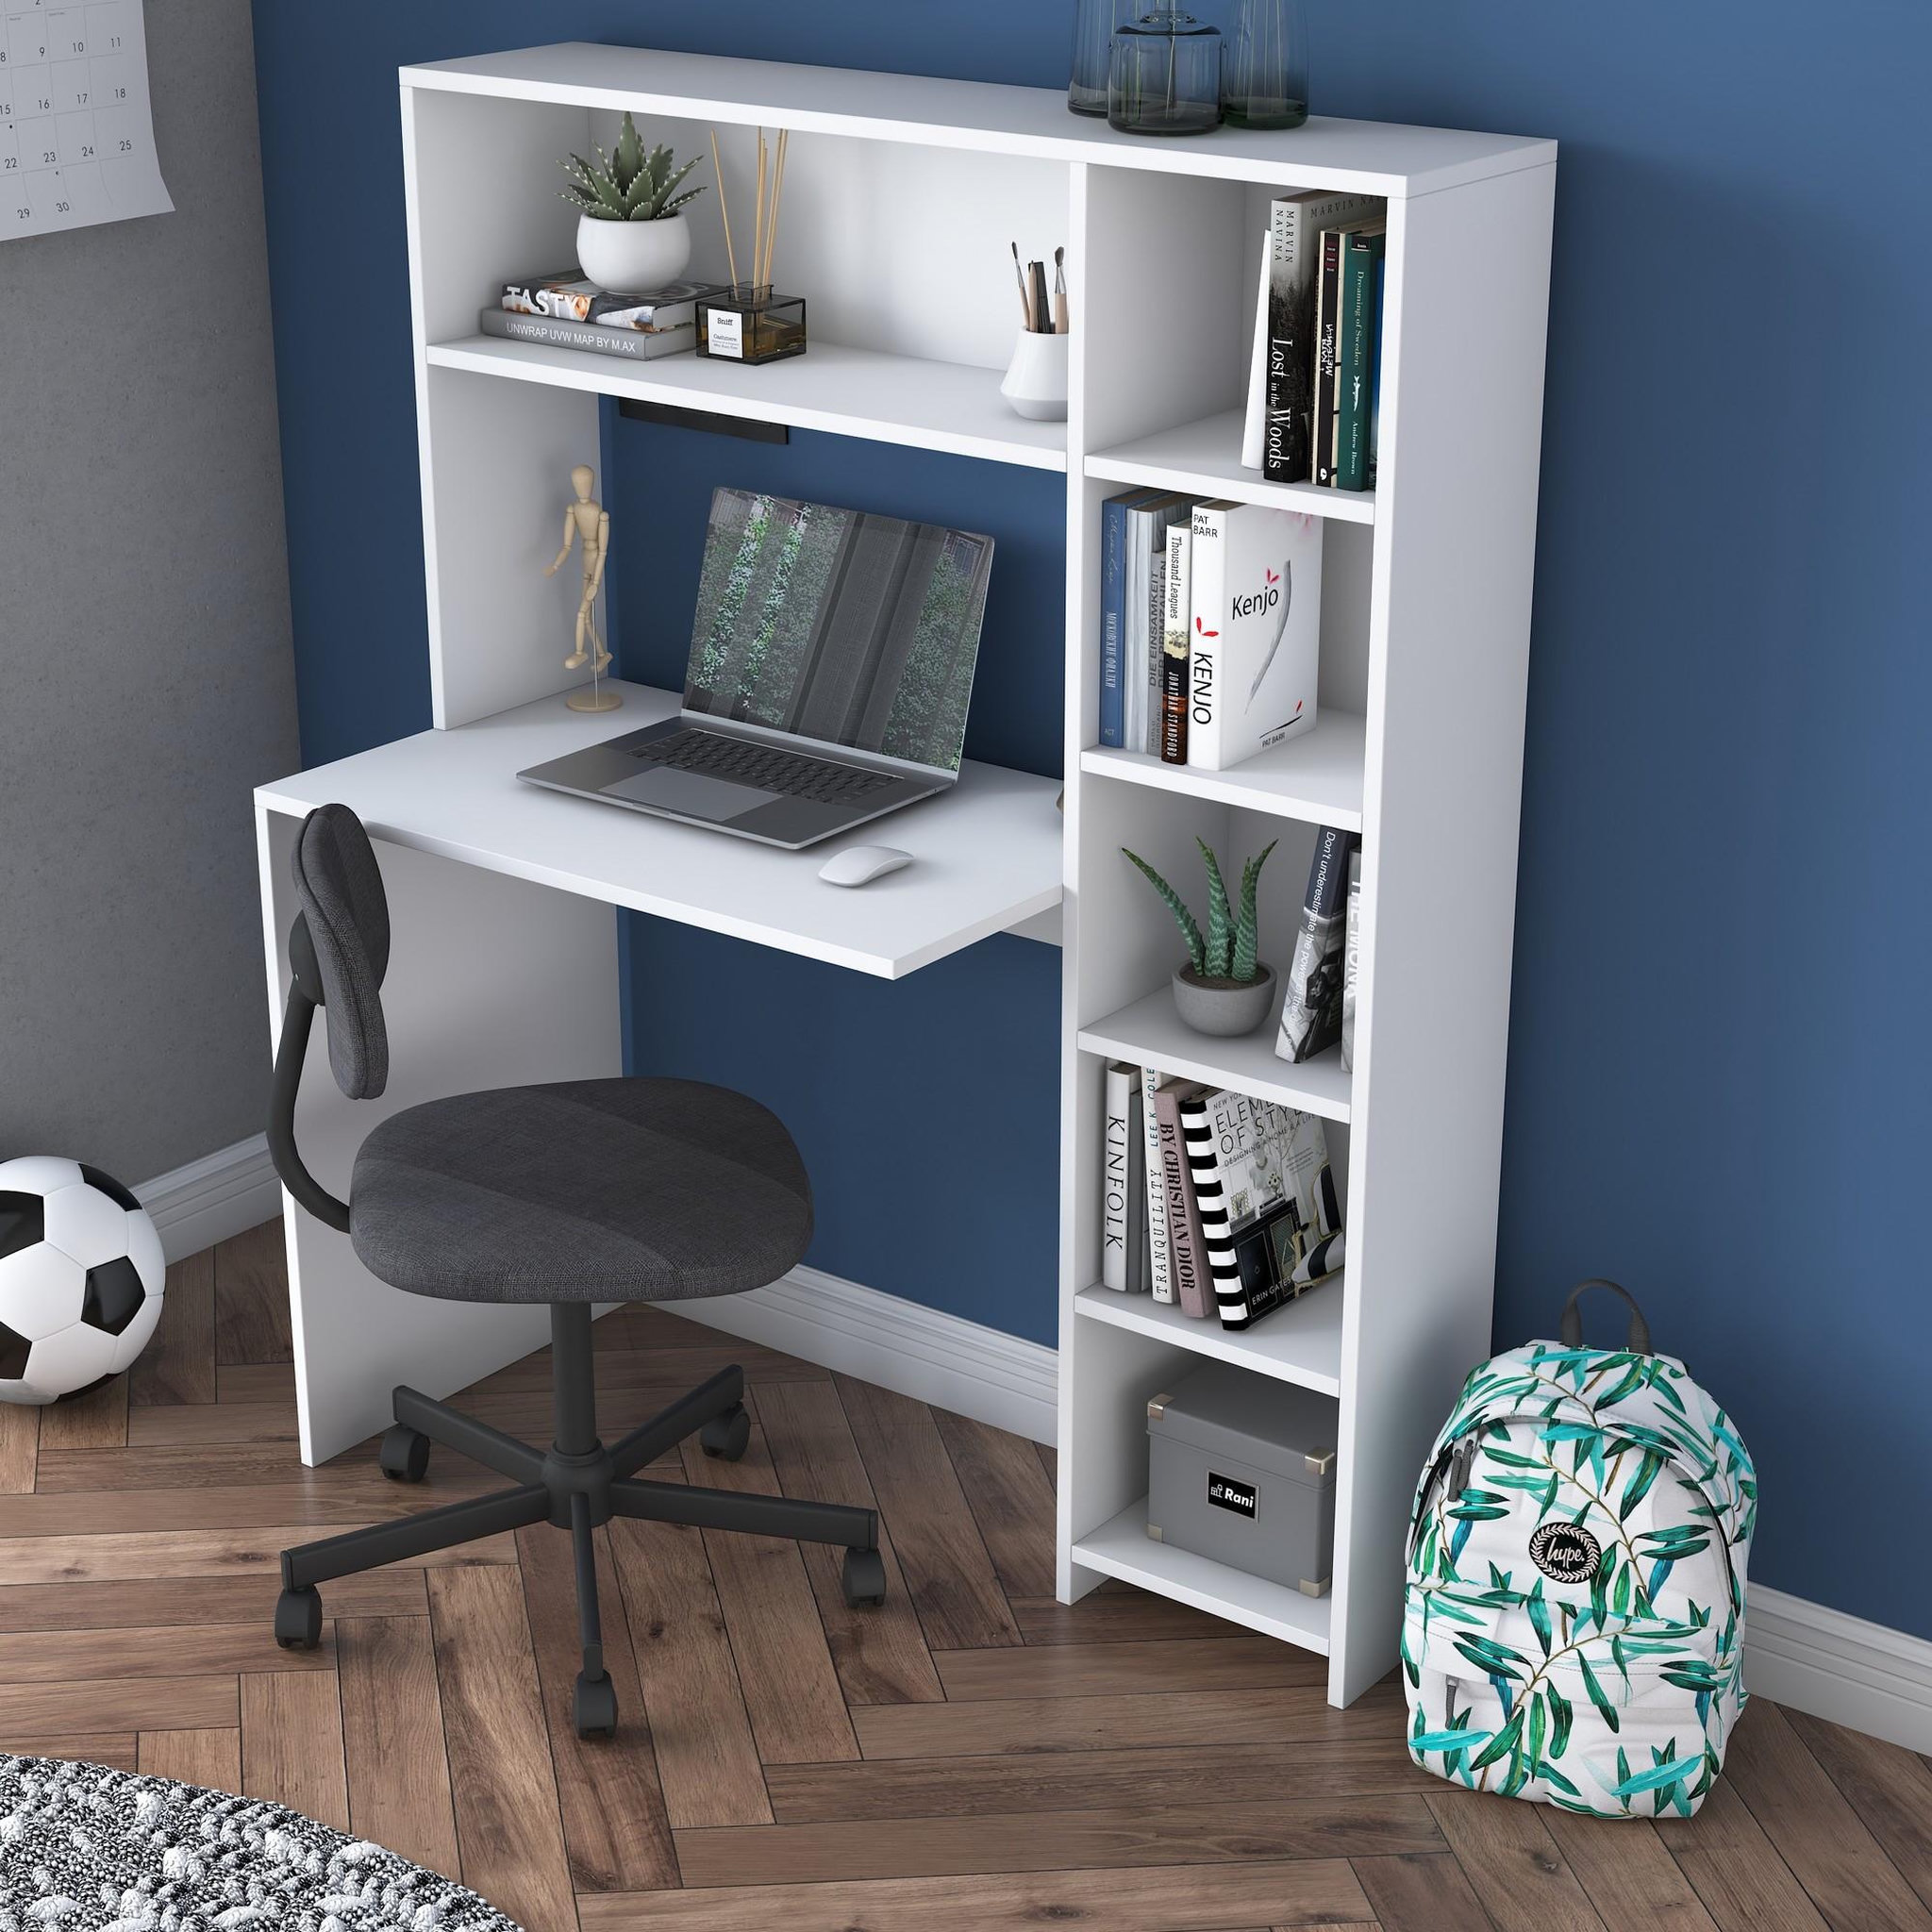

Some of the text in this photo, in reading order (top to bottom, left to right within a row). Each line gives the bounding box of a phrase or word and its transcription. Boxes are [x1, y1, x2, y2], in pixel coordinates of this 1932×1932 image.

[40, 47, 45, 57] 9
[73, 42, 84, 52] 10
[111, 37, 121, 47] 11
[39, 99, 50, 109] 16
[77, 93, 88, 104] 17
[115, 89, 126, 98] 18
[5, 141, 132, 169] 22 23 24 25
[17, 202, 69, 219] 29 30
[1310, 199, 1353, 219] MARVIN
[1274, 209, 1284, 261] NAVINA
[1285, 210, 1295, 263] MARVIN
[507, 286, 578, 320] TASTY
[1354, 271, 1364, 366] Dreaming of Sweden
[507, 323, 547, 337] UNWRAP
[550, 330, 573, 341] UVW
[574, 333, 594, 344] MAP
[597, 337, 609, 348] BY
[1268, 337, 1293, 469] Lost in the Woods
[1192, 514, 1209, 525] PAT
[1192, 525, 1218, 538] BARR
[1169, 536, 1182, 619] Thousand Leagues
[1231, 585, 1278, 621] Kenjo
[1149, 572, 1158, 687] DIE EINSAMKEIT
[1192, 651, 1213, 724] KENJO
[1167, 672, 1178, 758] JONATHAN STANDFORD
[1322, 831, 1336, 859] Don't
[1307, 859, 1328, 932] underestimate
[1304, 934, 1315, 950] the
[1298, 950, 1310, 981] power
[1291, 995, 1302, 1012] the
[1147, 1068, 1156, 1099] COLE
[1213, 1098, 1228, 1110] NEW
[1150, 1125, 1158, 1147] LEE
[1220, 1125, 1245, 1155] OF
[1224, 1141, 1262, 1167] DESIGNING
[1106, 1115, 1124, 1249] KINFOLK
[1159, 1124, 1196, 1289] BY CHRISTIAN DIOR
[1150, 1169, 1167, 1294] TRANQUILITY
[1252, 1277, 1291, 1305] ERIN GATES
[1224, 1488, 1254, 1508] Rani
